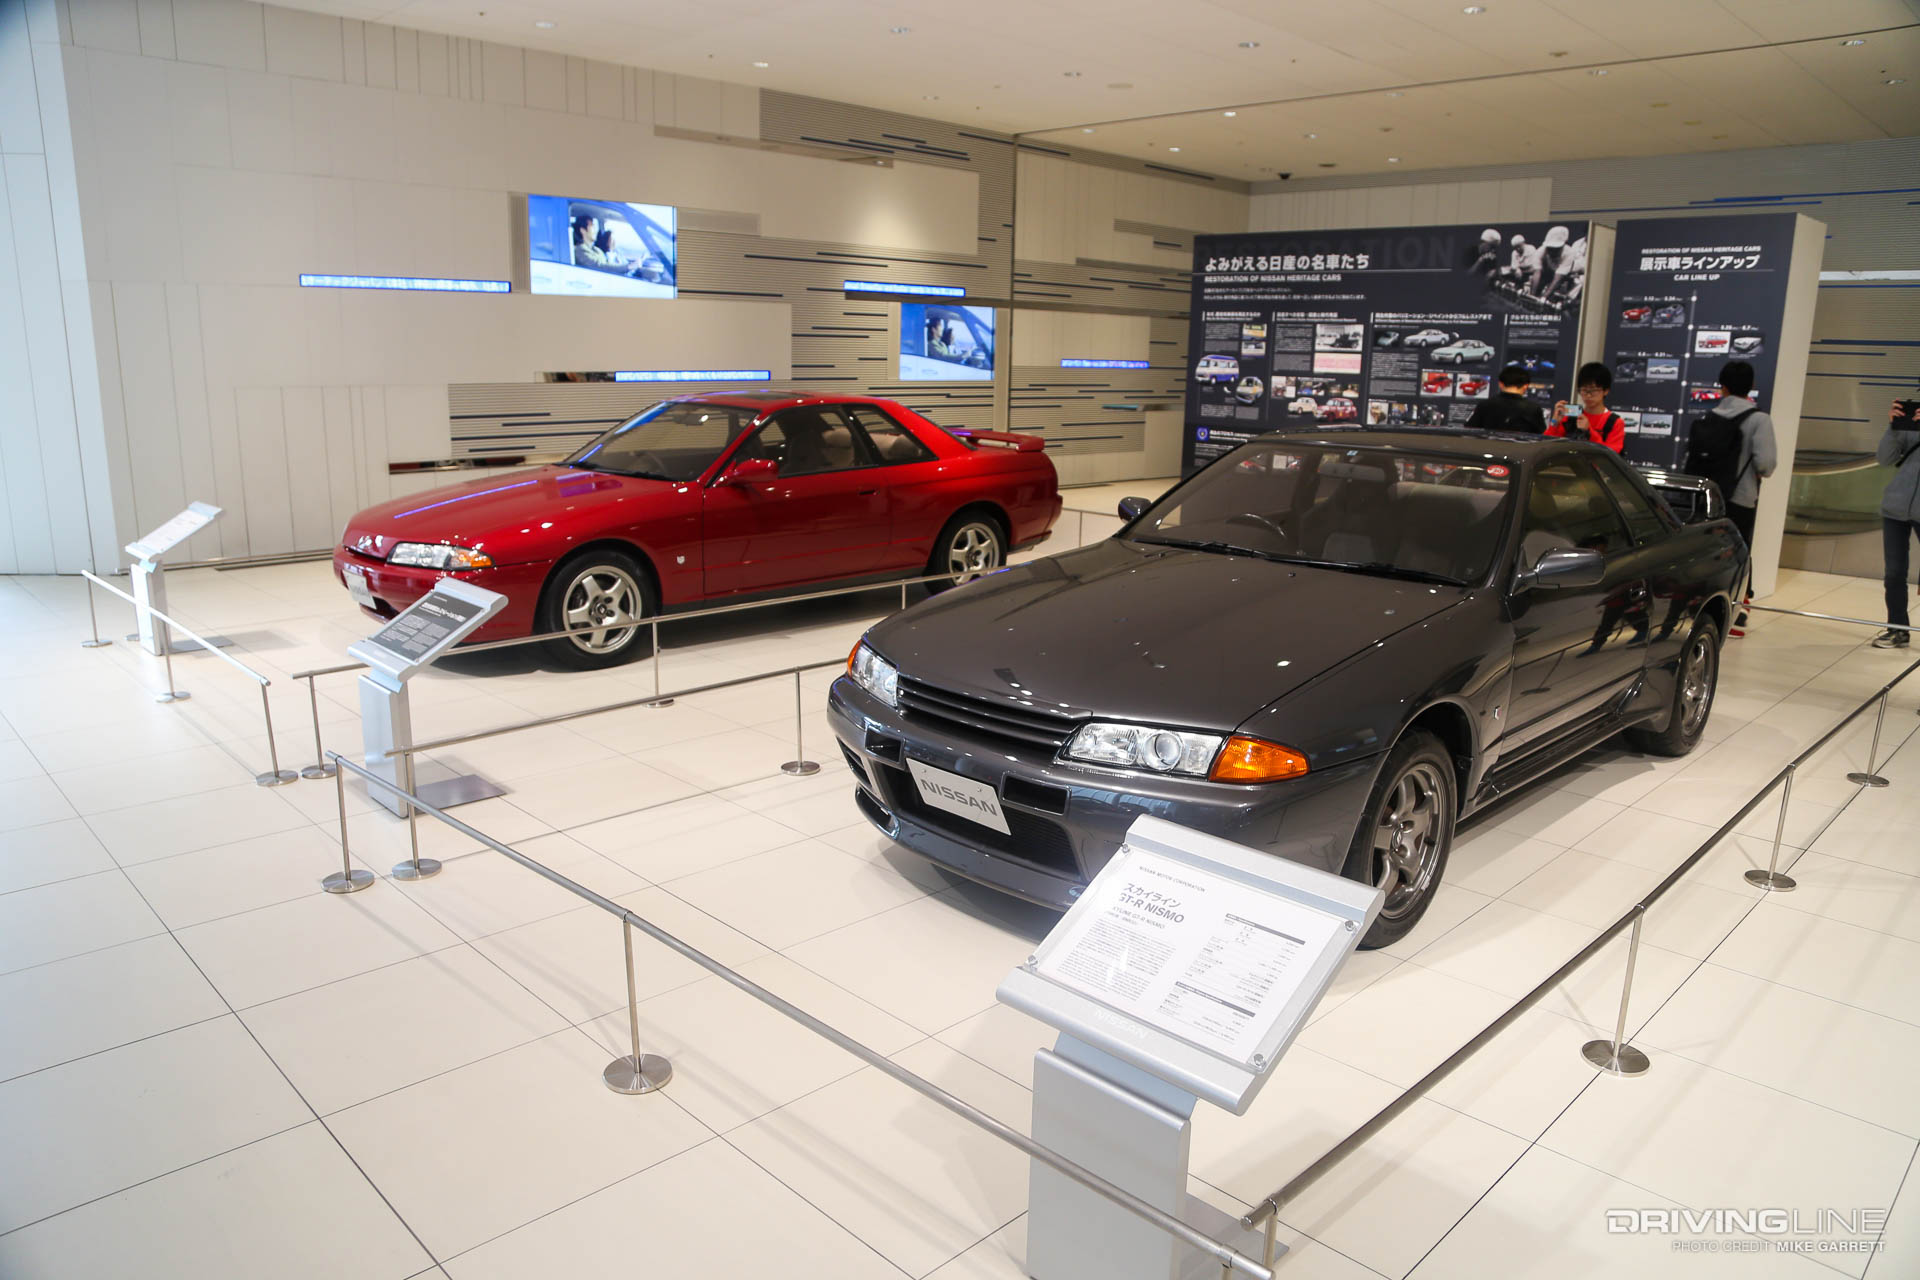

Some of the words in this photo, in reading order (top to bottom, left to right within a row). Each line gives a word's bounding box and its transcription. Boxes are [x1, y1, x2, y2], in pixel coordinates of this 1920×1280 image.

[1204, 253, 1370, 271] よみがえる日産の名車たち
[1639, 254, 1760, 271] 展示車ラインアップ
[1204, 275, 1249, 283] RESTORATION
[1287, 274, 1321, 282] HERITAGE
[920, 779, 998, 816] NISSAN
[1156, 871, 1173, 882] MOTOR
[1173, 877, 1206, 893] CORPORATION
[1123, 882, 1182, 909] スカイライン
[1144, 902, 1185, 924] NISMO
